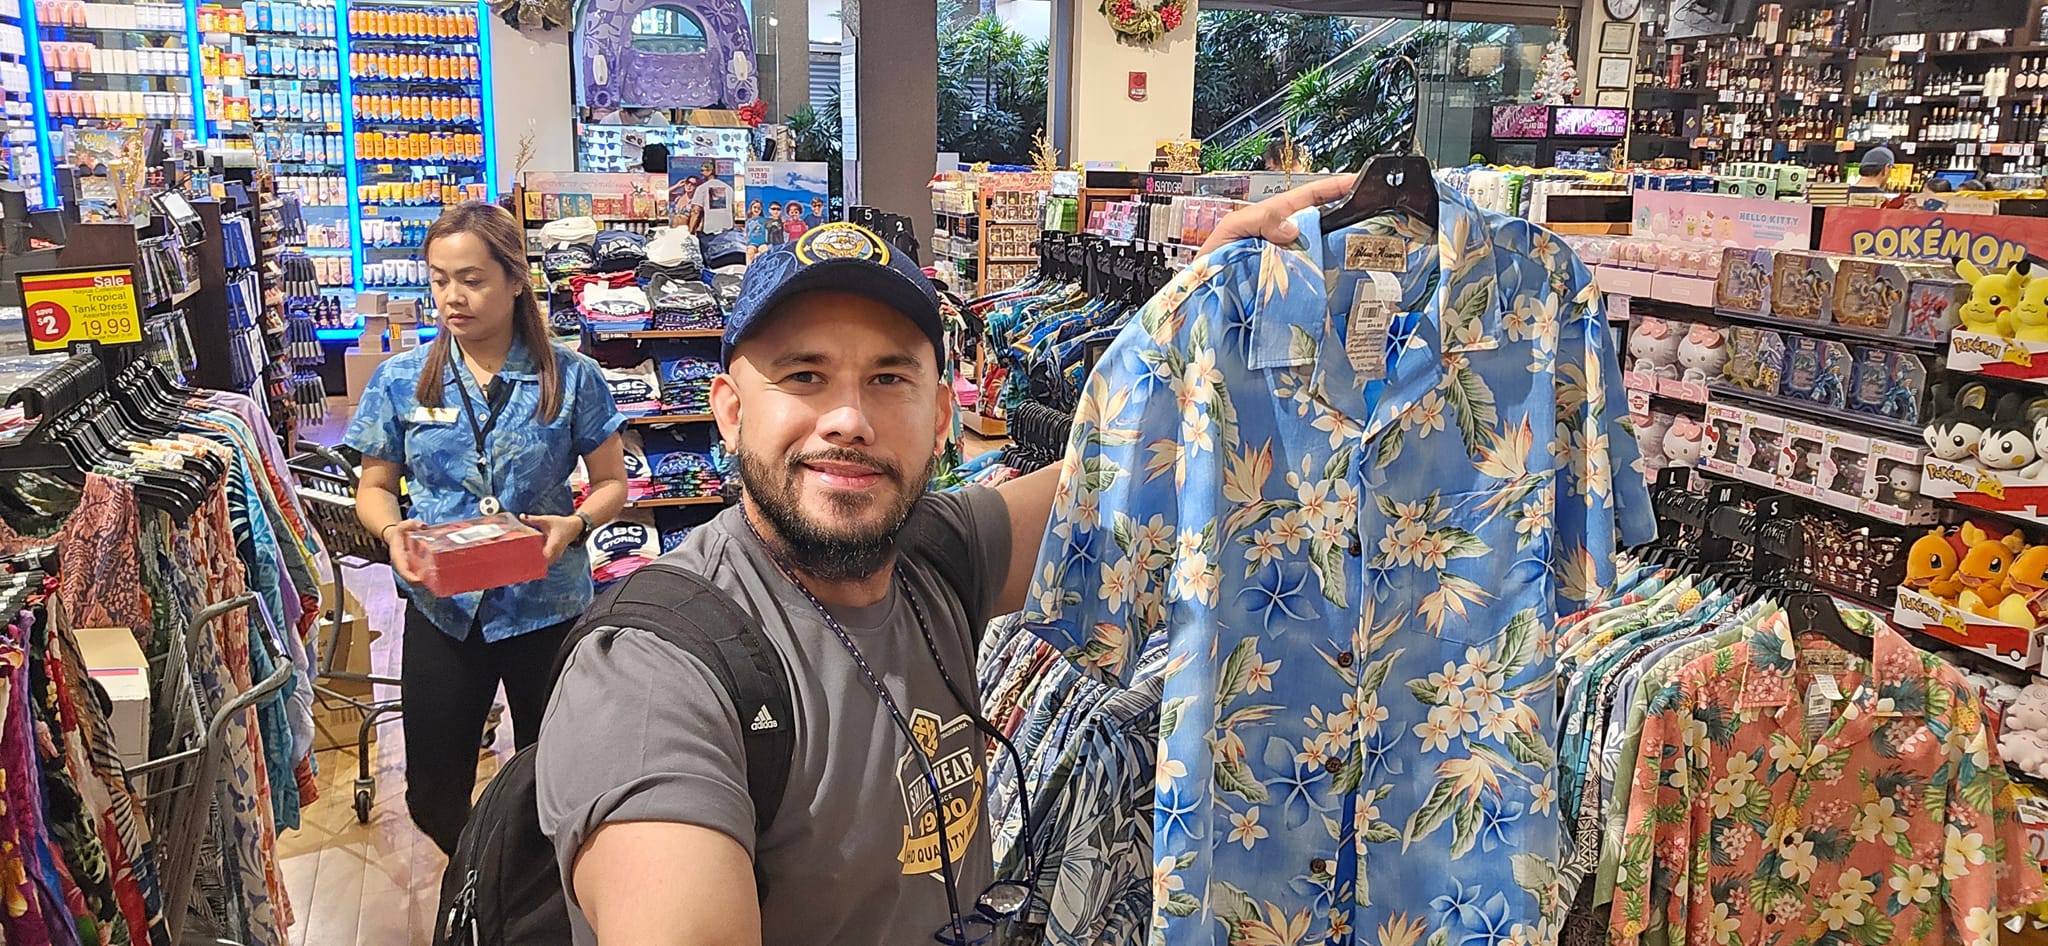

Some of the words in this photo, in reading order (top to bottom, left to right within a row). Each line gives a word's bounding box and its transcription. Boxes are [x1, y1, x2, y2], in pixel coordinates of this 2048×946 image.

[864, 208, 873, 221] 5
[1739, 212, 1767, 223] HELLO
[1769, 215, 1800, 226] KITTY
[895, 220, 904, 232] 2
[1095, 240, 1104, 252] 5
[1852, 217, 2028, 267] POKÉMON
[1118, 248, 1125, 257] 4
[1152, 256, 1158, 265] 2
[94, 275, 124, 287] Sale
[86, 292, 126, 303] Tropical
[72, 305, 97, 314] Tank
[99, 303, 128, 312] Dress
[37, 315, 59, 335] $2
[81, 317, 131, 337] 19.99
[1669, 472, 1676, 484] L
[1720, 489, 1731, 502] M
[1770, 501, 1778, 516] S
[598, 525, 643, 543] ABC
[602, 537, 641, 550] STORES
[751, 719, 778, 731] adidas
[917, 830, 965, 863] QUAITY
